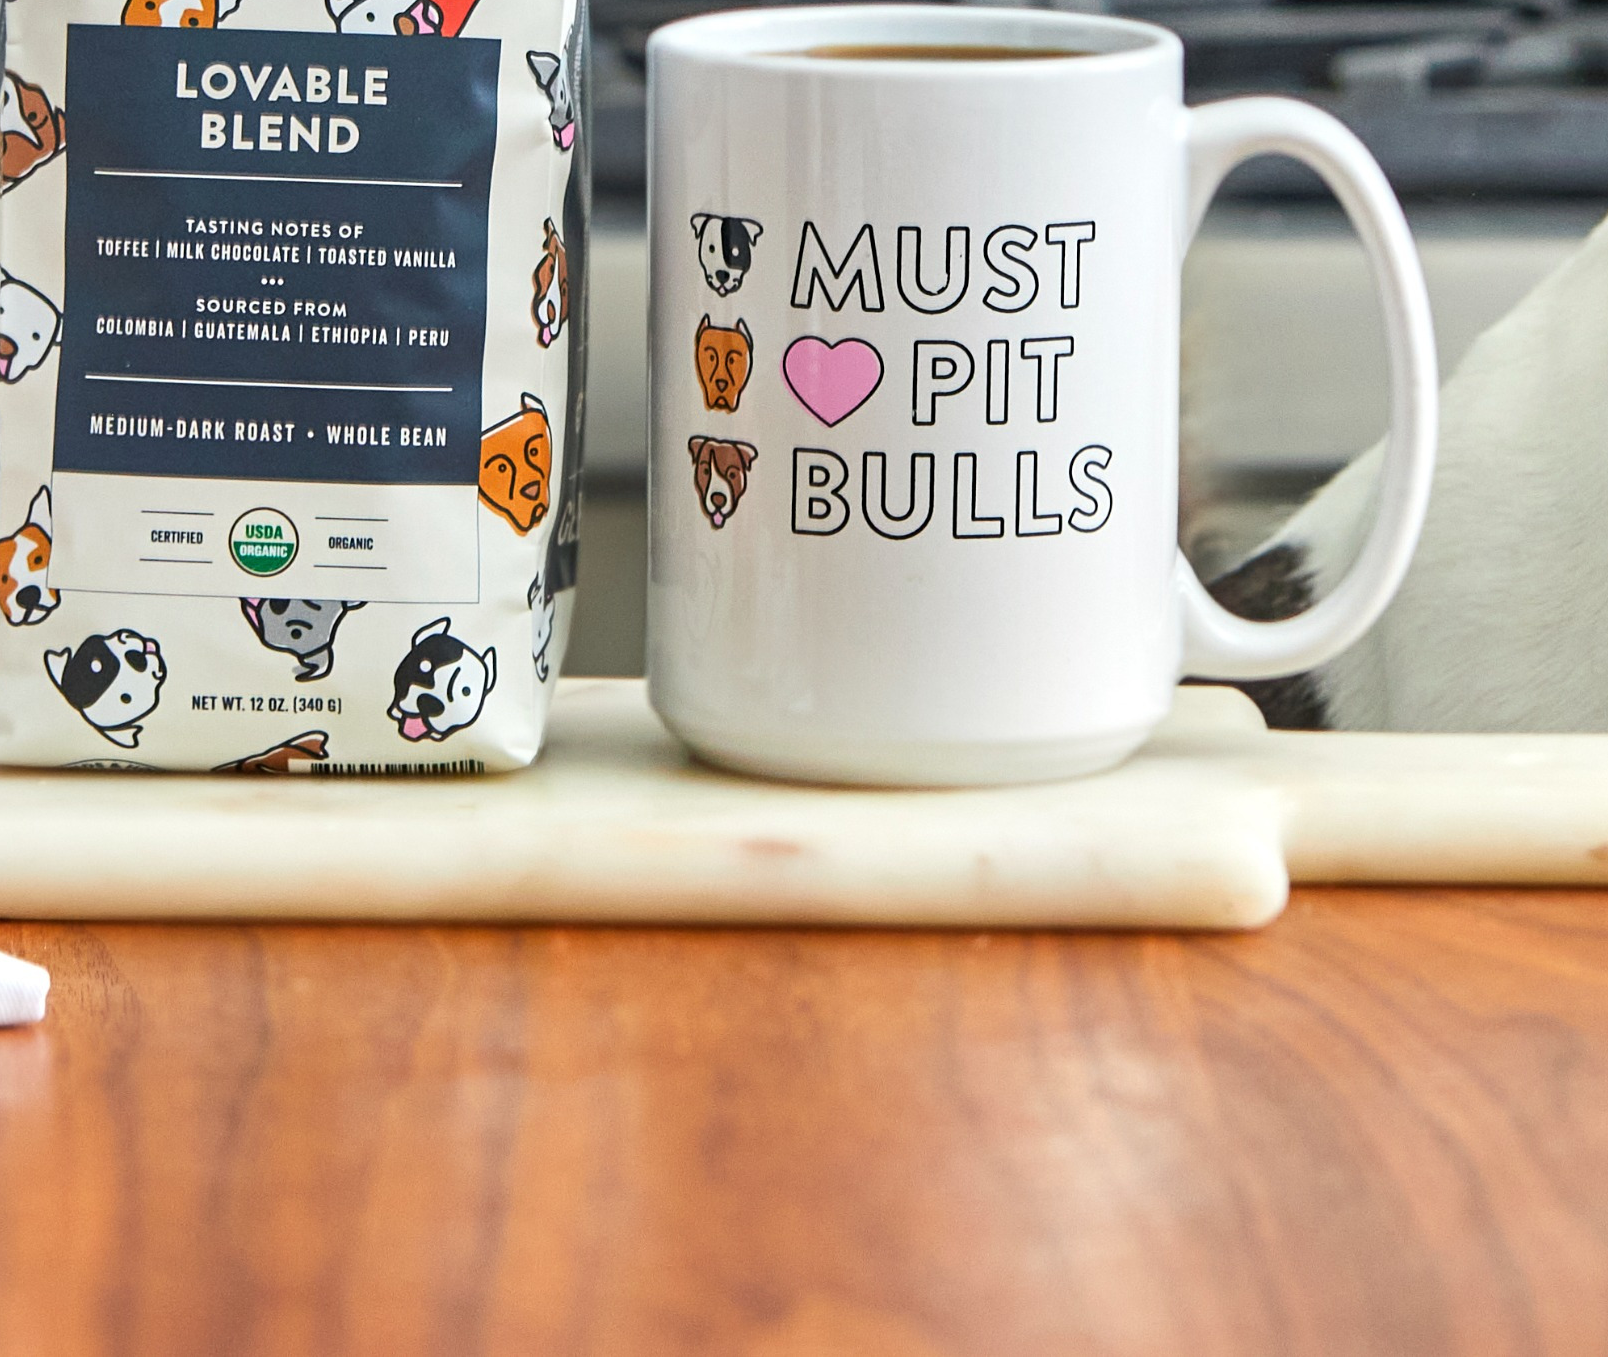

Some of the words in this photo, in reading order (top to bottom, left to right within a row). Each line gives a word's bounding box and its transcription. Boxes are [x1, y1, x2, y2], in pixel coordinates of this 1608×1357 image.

[176, 62, 389, 106] LOVABLE
[200, 112, 360, 154] BLEND
[185, 218, 264, 236] TASTING
[271, 221, 332, 238] NOTES
[338, 224, 364, 239] OF
[96, 238, 149, 258] TOFFEE
[166, 241, 205, 260] MILK
[210, 243, 300, 264] CHOCOLATE
[318, 247, 387, 267] TOASTED
[393, 249, 456, 269] VANILLA
[789, 220, 1096, 316] MUST
[196, 298, 286, 315] SOURCED
[293, 301, 347, 318] FROM
[96, 317, 174, 338] COLOMBIA
[194, 321, 291, 342] GUATEMALA
[311, 326, 388, 345] ETHIOPIA
[408, 329, 449, 347] PERU
[911, 335, 1075, 427] PIT
[89, 415, 225, 440] MEDIUM-DARK
[234, 421, 295, 443] ROAST
[326, 425, 391, 446] WHOLE
[400, 427, 447, 447] BEAN
[790, 444, 1113, 541] BULLS
[150, 529, 204, 545] CERTIFIED
[245, 524, 284, 540] USDA
[328, 536, 374, 551] ORGANIC
[238, 543, 289, 559] ORGANIC
[191, 695, 218, 711] NET
[221, 696, 246, 711] WT.
[250, 696, 264, 712] 12
[268, 697, 289, 712] OZ.
[293, 696, 324, 714] (340
[327, 697, 342, 715] G)
